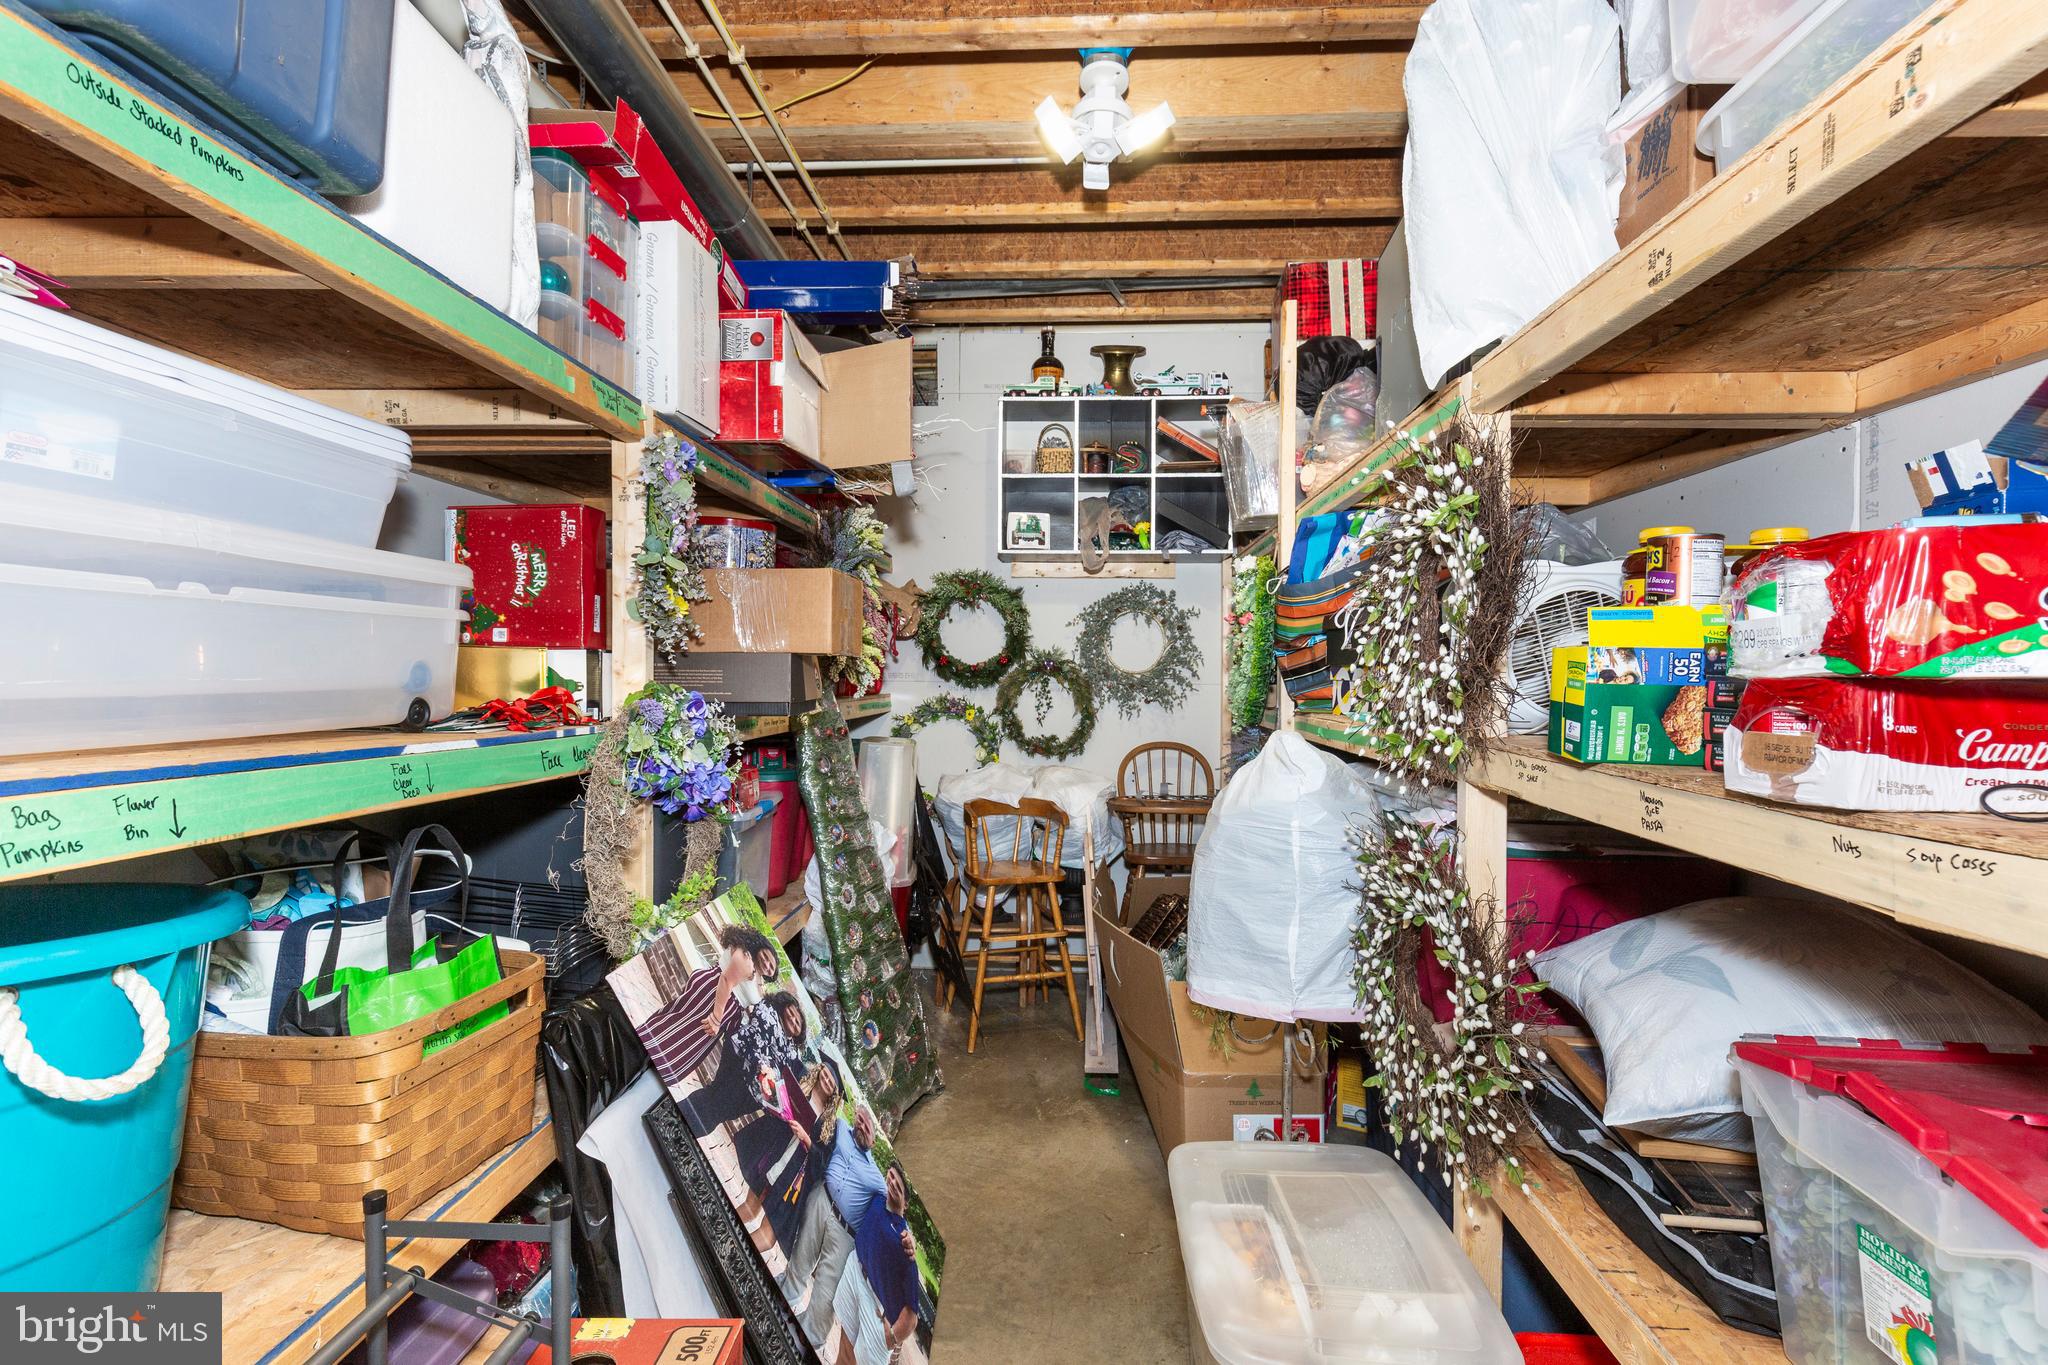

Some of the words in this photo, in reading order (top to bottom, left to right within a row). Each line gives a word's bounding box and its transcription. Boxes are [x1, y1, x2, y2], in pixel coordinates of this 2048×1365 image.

[66, 62, 124, 110] Outside
[130, 99, 182, 146] Stacked
[190, 136, 244, 182] Pumpkins
[1787, 147, 1798, 194] SELECT
[680, 199, 707, 246] Snowman
[646, 232, 658, 280] Gnomes
[1657, 247, 1665, 259] 2
[646, 293, 658, 342] Gnomes
[724, 321, 735, 359] Holiday
[735, 321, 743, 359] ACCENTS
[566, 519, 576, 538] LED
[527, 553, 548, 598] MERRY
[1673, 658, 1687, 677] 50
[1689, 651, 1702, 683] EARN
[1617, 711, 1626, 727] OATS
[1883, 716, 1894, 731] 8
[1895, 725, 1917, 734] CANS
[2003, 723, 2048, 731] CONDE
[1614, 735, 1624, 755] HONEY
[390, 761, 412, 776] Fall
[540, 750, 564, 772] Fall
[392, 777, 413, 791] Clear
[402, 787, 420, 799] Deco
[11, 805, 61, 831] Bag
[1641, 817, 1664, 832] PASTA
[123, 824, 149, 841] Bin
[0, 840, 84, 868] Pumpkins
[1832, 834, 1862, 858] Nuts
[1906, 848, 1943, 873] Soup
[1860, 1227, 1926, 1278] HOLIDAY
[1860, 1236, 1906, 1278] ORNAMENT
[1908, 1270, 1928, 1291] BOX
[676, 1336, 707, 1362] 500
